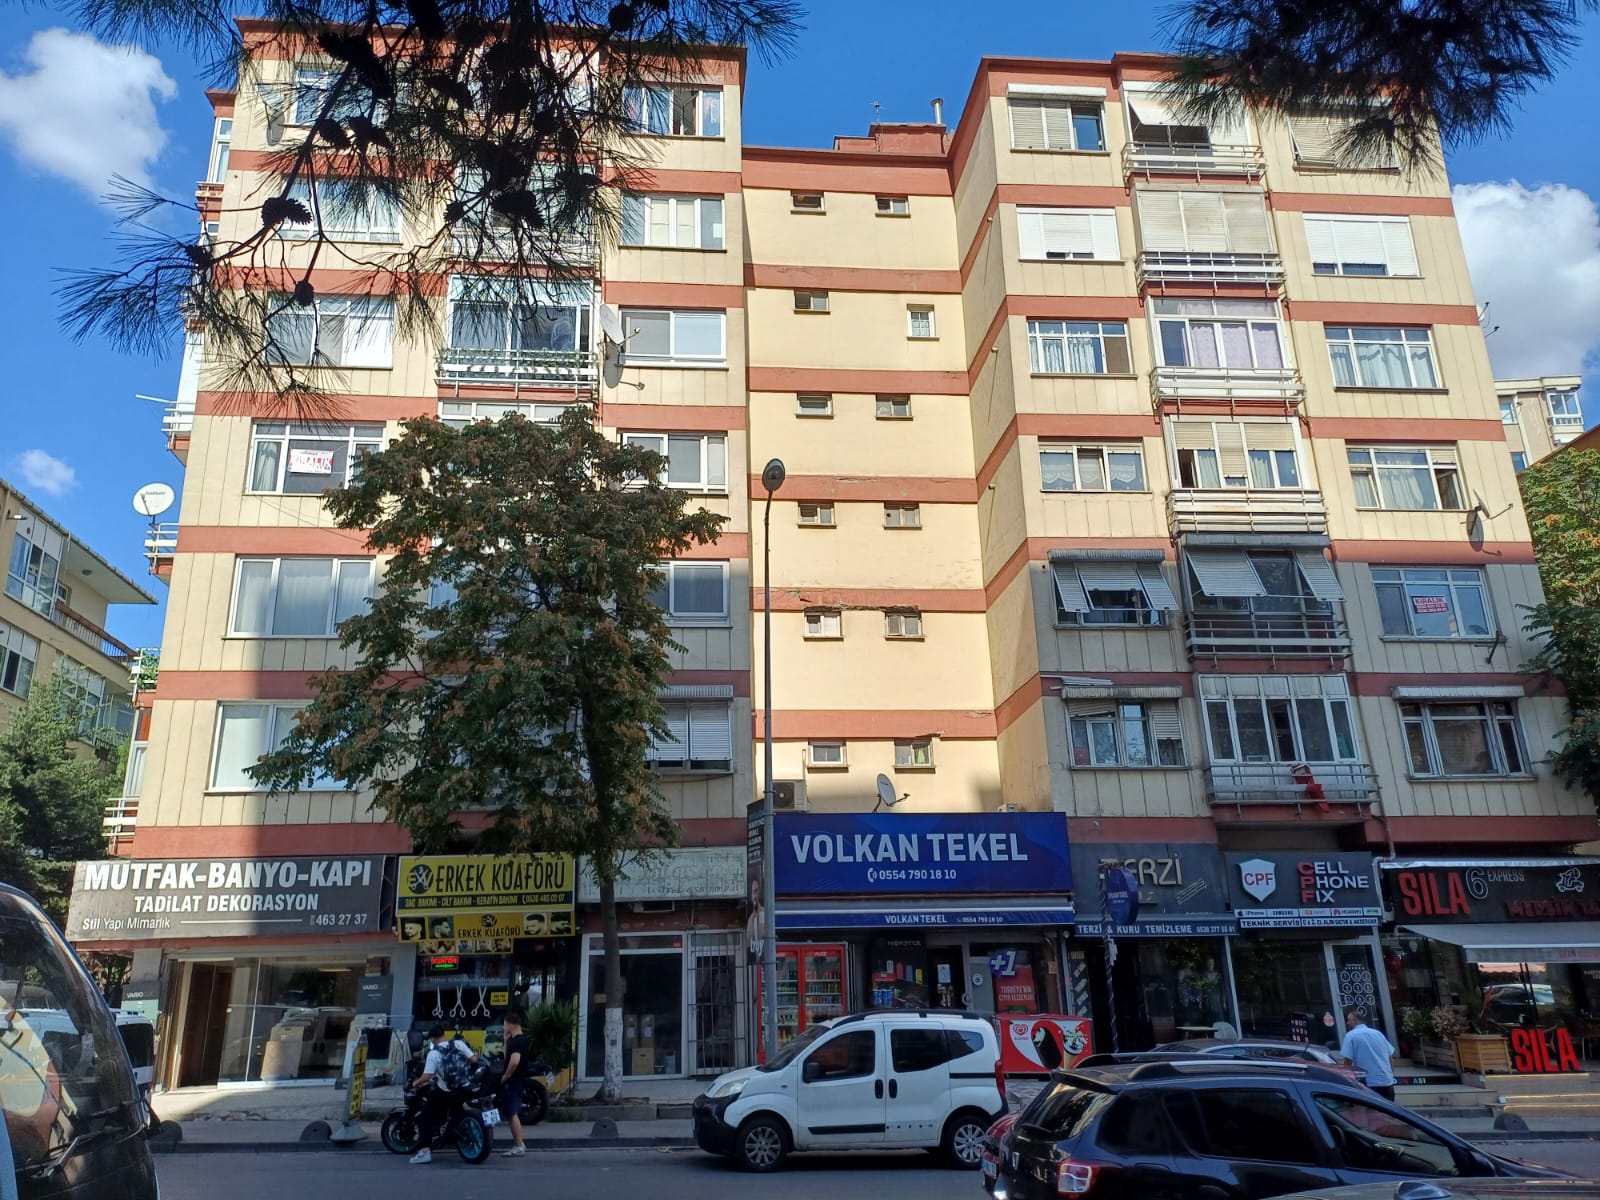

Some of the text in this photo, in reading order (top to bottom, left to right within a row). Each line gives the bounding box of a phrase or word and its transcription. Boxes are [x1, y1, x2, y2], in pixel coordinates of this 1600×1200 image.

[790, 834, 920, 863] VOLKAN
[926, 832, 1028, 862] TEKEL
[84, 860, 372, 890] MUTFAK-BANYO-KAPI
[879, 868, 956, 880] 0554 790 18 10
[1298, 861, 1350, 876] CELL
[436, 864, 486, 892] ERKEK
[1244, 872, 1272, 886] CPF
[1300, 876, 1369, 888] PHONE
[1302, 890, 1336, 904] FIX
[1398, 872, 1471, 916] SILA
[1488, 870, 1525, 882] EXPRESS
[207, 894, 318, 912] DEKORASYON
[82, 917, 170, 932] Stil Yapı Mimarlık
[316, 914, 336, 926] 463
[338, 914, 352, 926] 27
[354, 914, 368, 925] 37
[885, 914, 947, 924] VOLKAN TEKEL
[458, 928, 482, 938] ERKEK
[1078, 924, 1101, 934] TERZİ
[1117, 925, 1140, 934] KURU
[1145, 923, 1192, 934] TEMİZLEME
[990, 950, 1016, 976] +1
[1511, 1027, 1580, 1072] SILA
